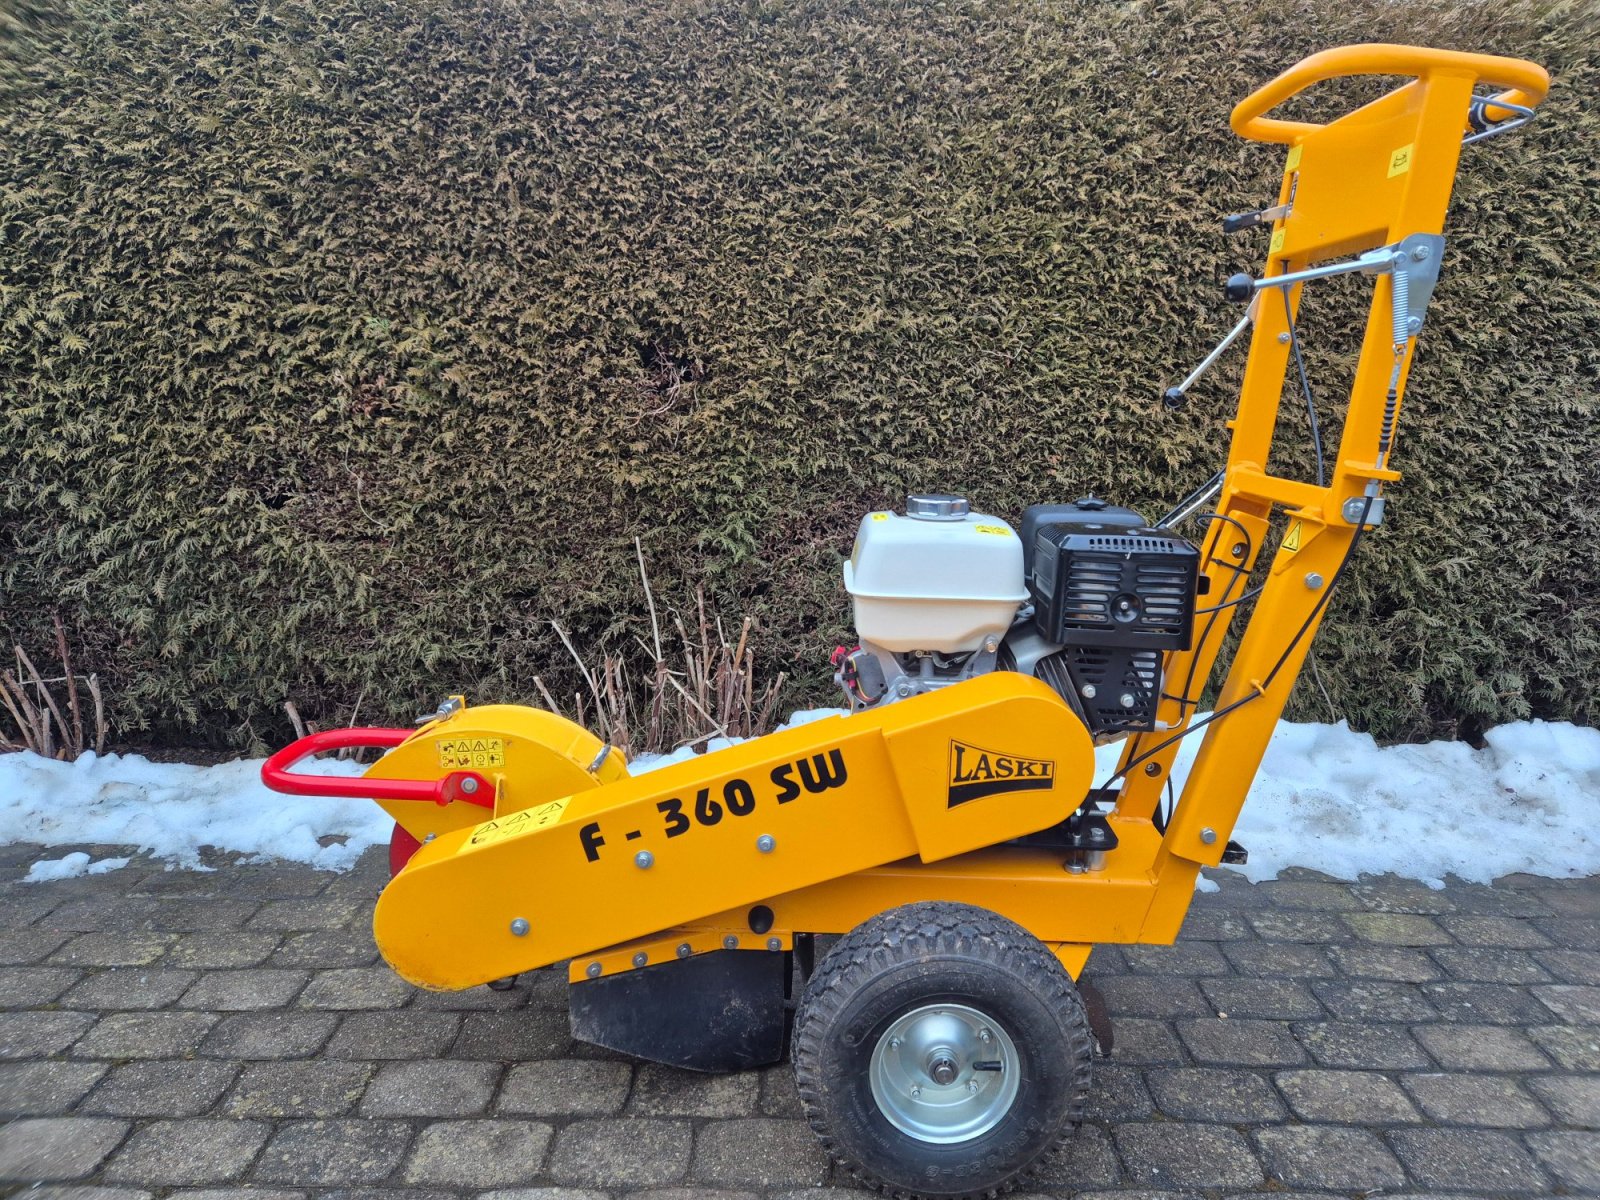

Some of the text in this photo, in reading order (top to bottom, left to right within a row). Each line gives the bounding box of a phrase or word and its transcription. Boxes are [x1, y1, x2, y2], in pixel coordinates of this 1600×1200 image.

[953, 744, 1051, 783] LASKI
[579, 748, 848, 863] F - 360 SW
